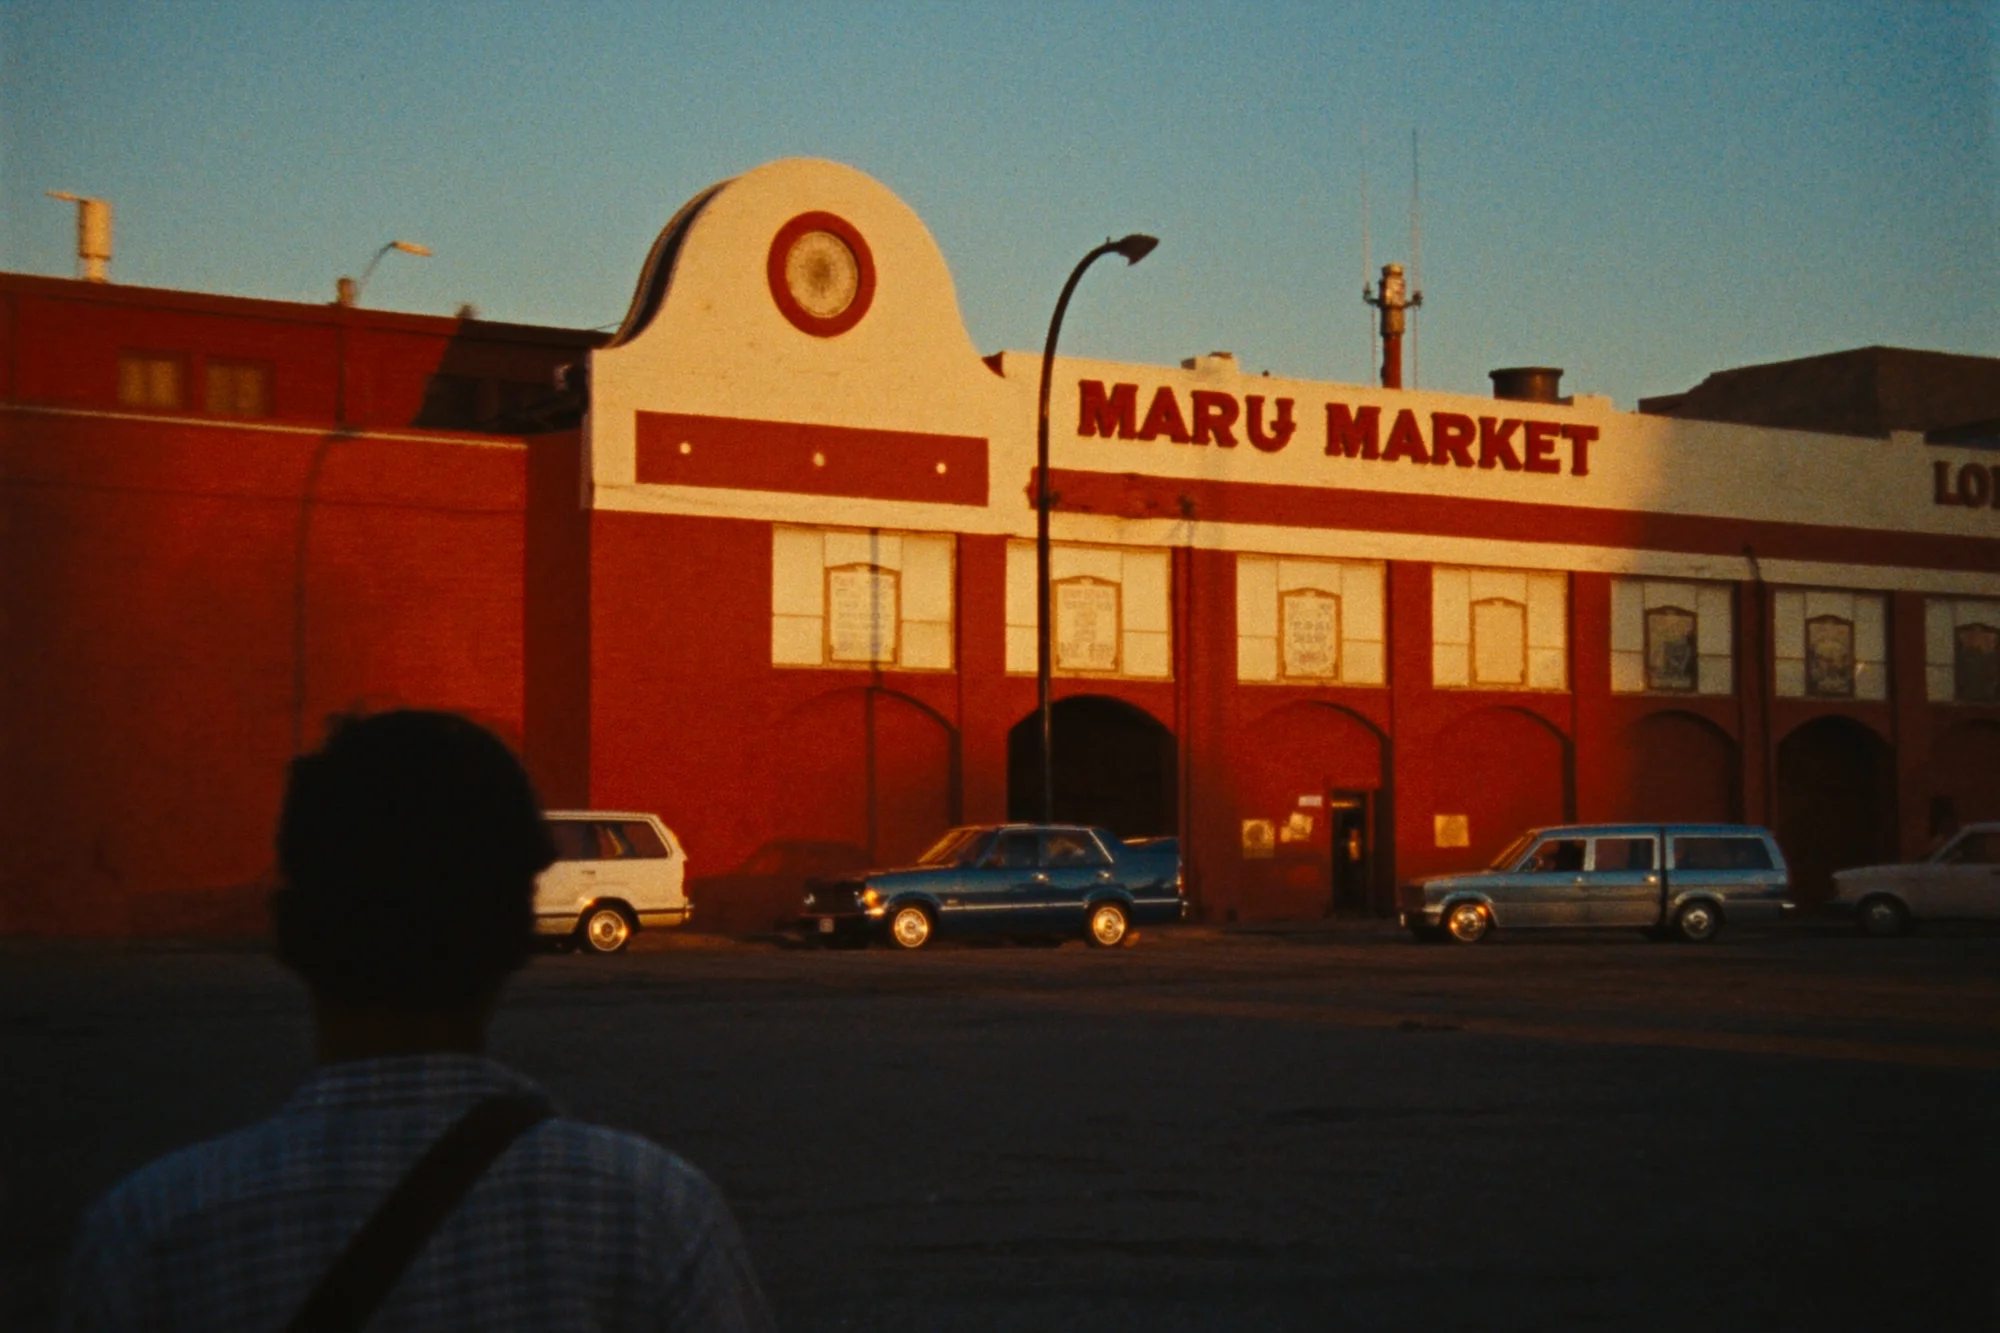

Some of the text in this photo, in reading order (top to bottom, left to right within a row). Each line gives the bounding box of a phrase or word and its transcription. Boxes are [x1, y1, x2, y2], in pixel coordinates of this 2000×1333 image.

[1077, 379, 1599, 476] MARU MARKET
[1933, 460, 2000, 510] LO
